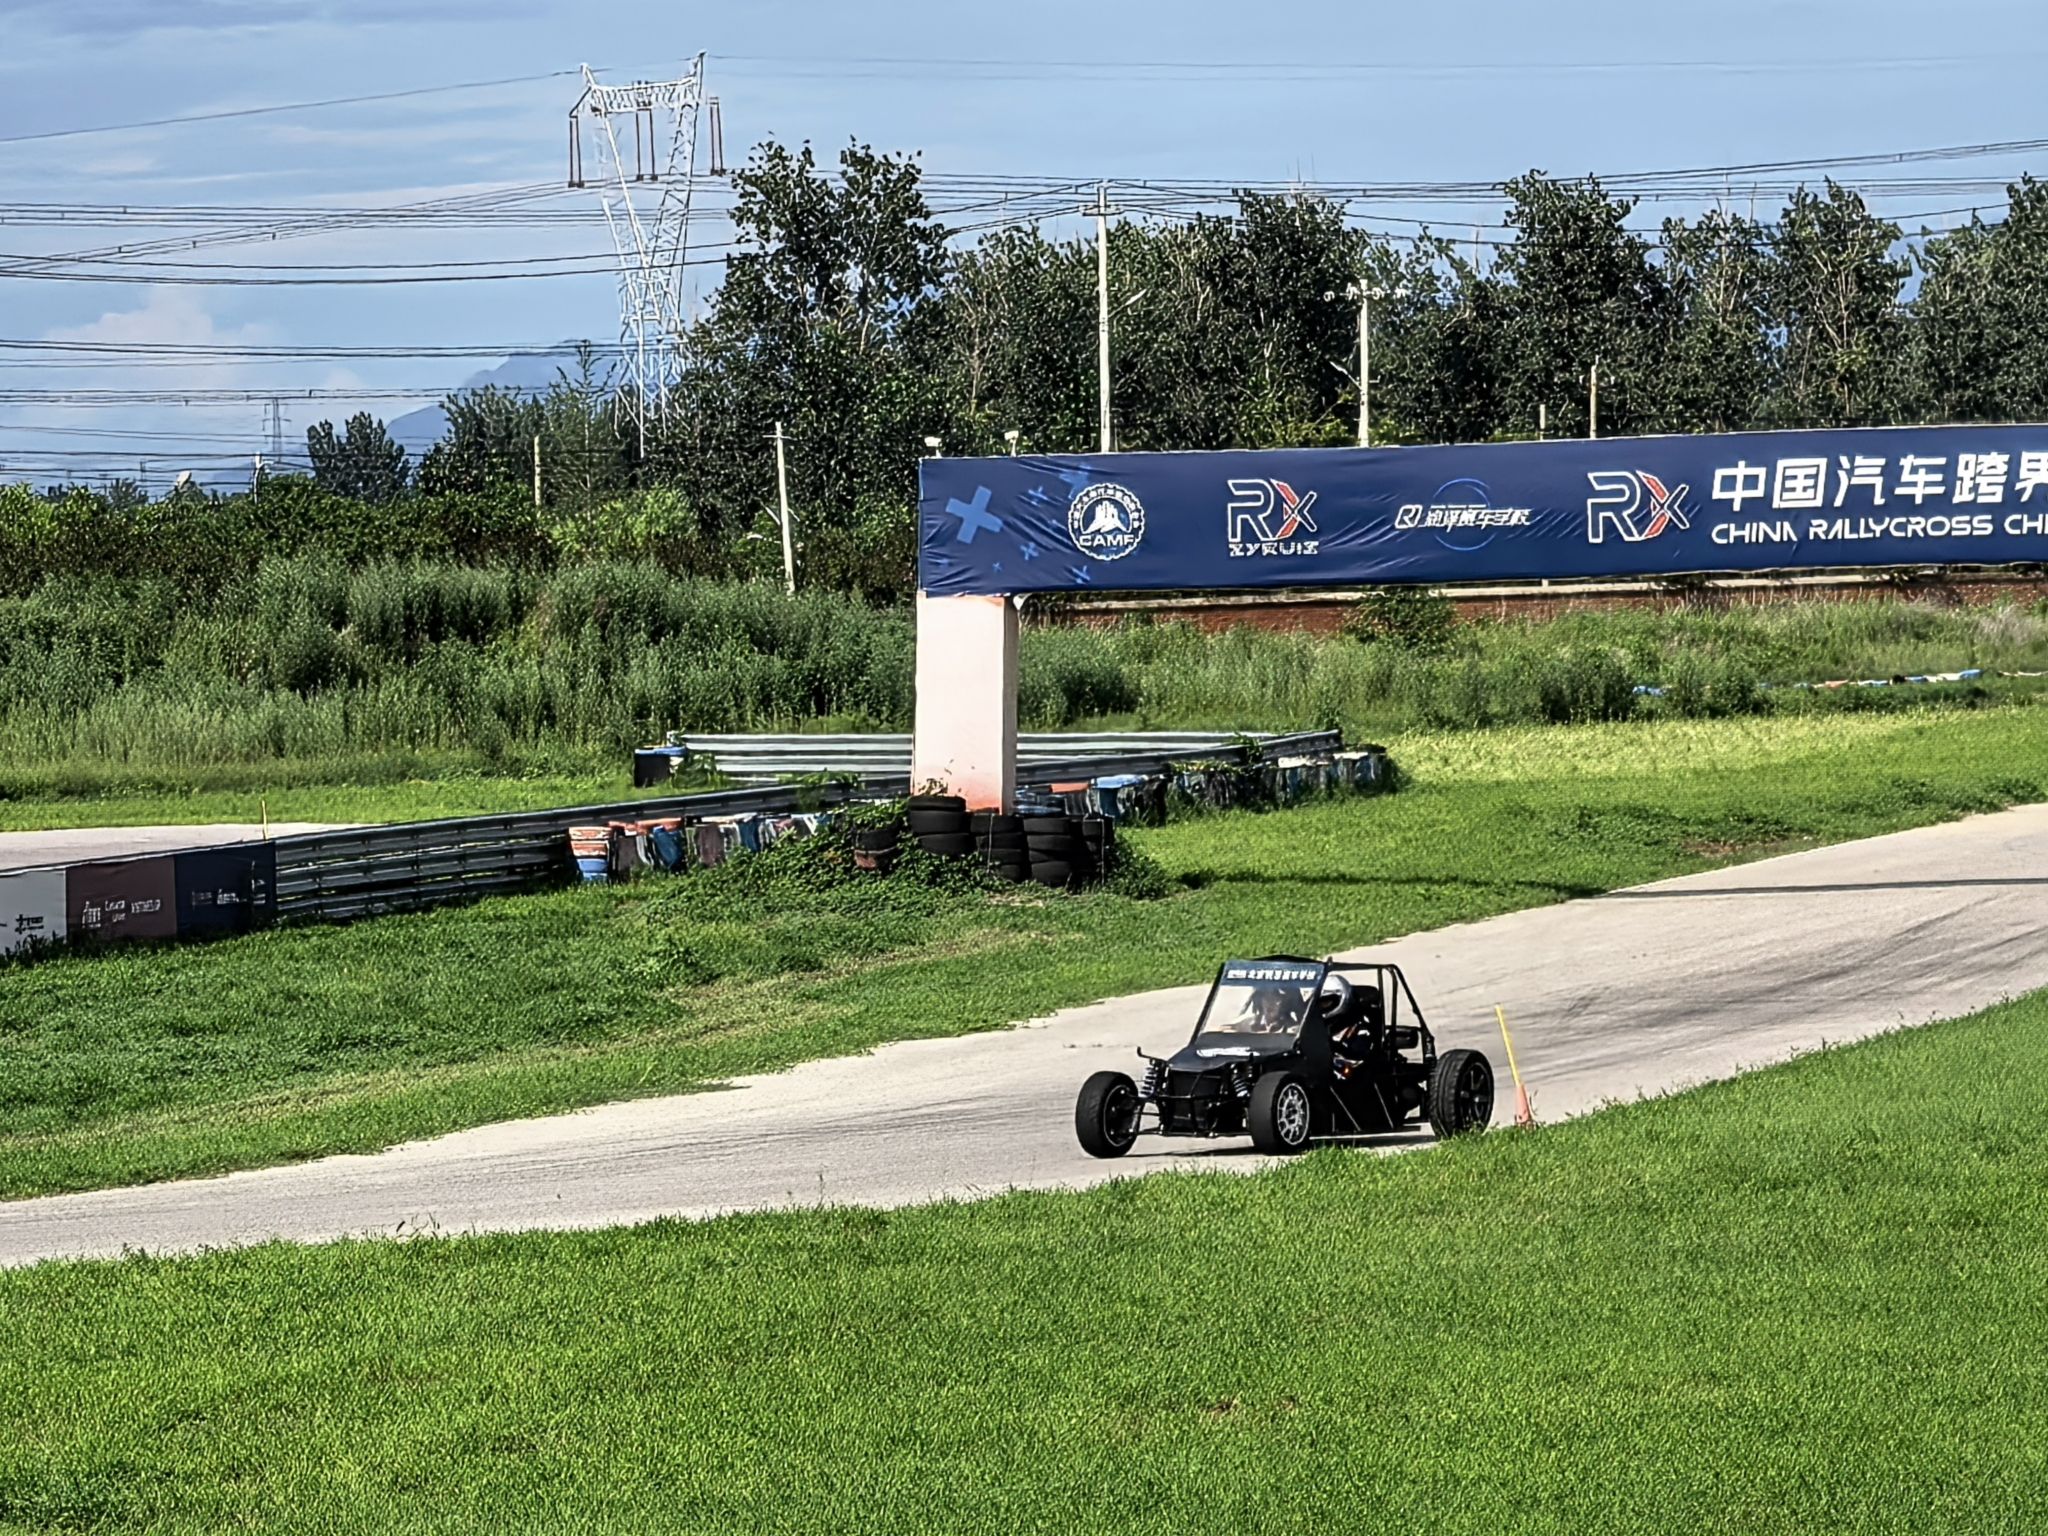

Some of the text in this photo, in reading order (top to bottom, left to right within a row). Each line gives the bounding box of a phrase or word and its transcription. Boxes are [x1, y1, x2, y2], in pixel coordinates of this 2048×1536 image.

[1711, 451, 2048, 512] 中国汽车跨界
[1080, 534, 1134, 547] CAMF
[1711, 521, 1798, 544] CHINA
[1809, 514, 1994, 540] RALLYCROSS
